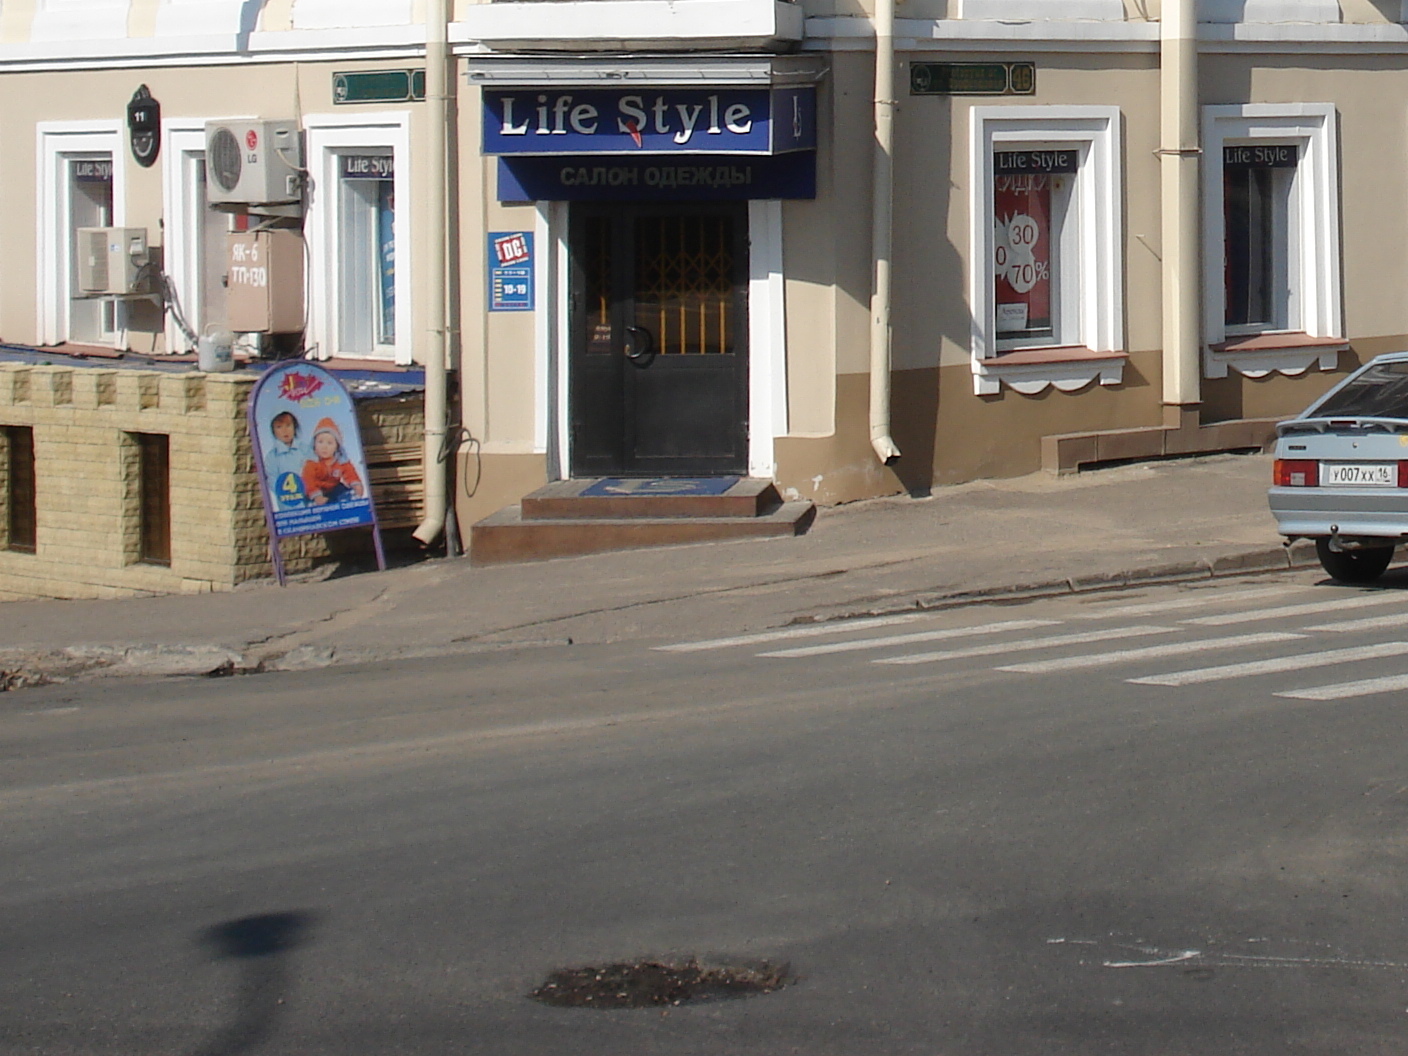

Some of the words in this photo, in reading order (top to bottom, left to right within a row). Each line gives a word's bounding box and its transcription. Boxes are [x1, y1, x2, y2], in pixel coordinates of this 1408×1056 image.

[134, 111, 145, 122] 11
[500, 95, 598, 135] Life
[617, 95, 752, 146] Style
[247, 154, 258, 164] LG
[346, 156, 369, 173] Life
[371, 155, 394, 176] Styl
[1000, 152, 1026, 169] Life
[1031, 150, 1068, 171] Style
[1226, 148, 1250, 164] Life
[1255, 146, 1288, 165] Style
[94, 162, 112, 180] Styl
[560, 166, 638, 187] САЛОН
[644, 165, 751, 189] ОДЕЖДЫ
[1012, 224, 1034, 245] 30
[232, 243, 259, 262] ЯК-6
[502, 239, 523, 260] DC
[996, 245, 1007, 265] 0
[503, 284, 527, 295] 10-19
[282, 473, 297, 493] 4
